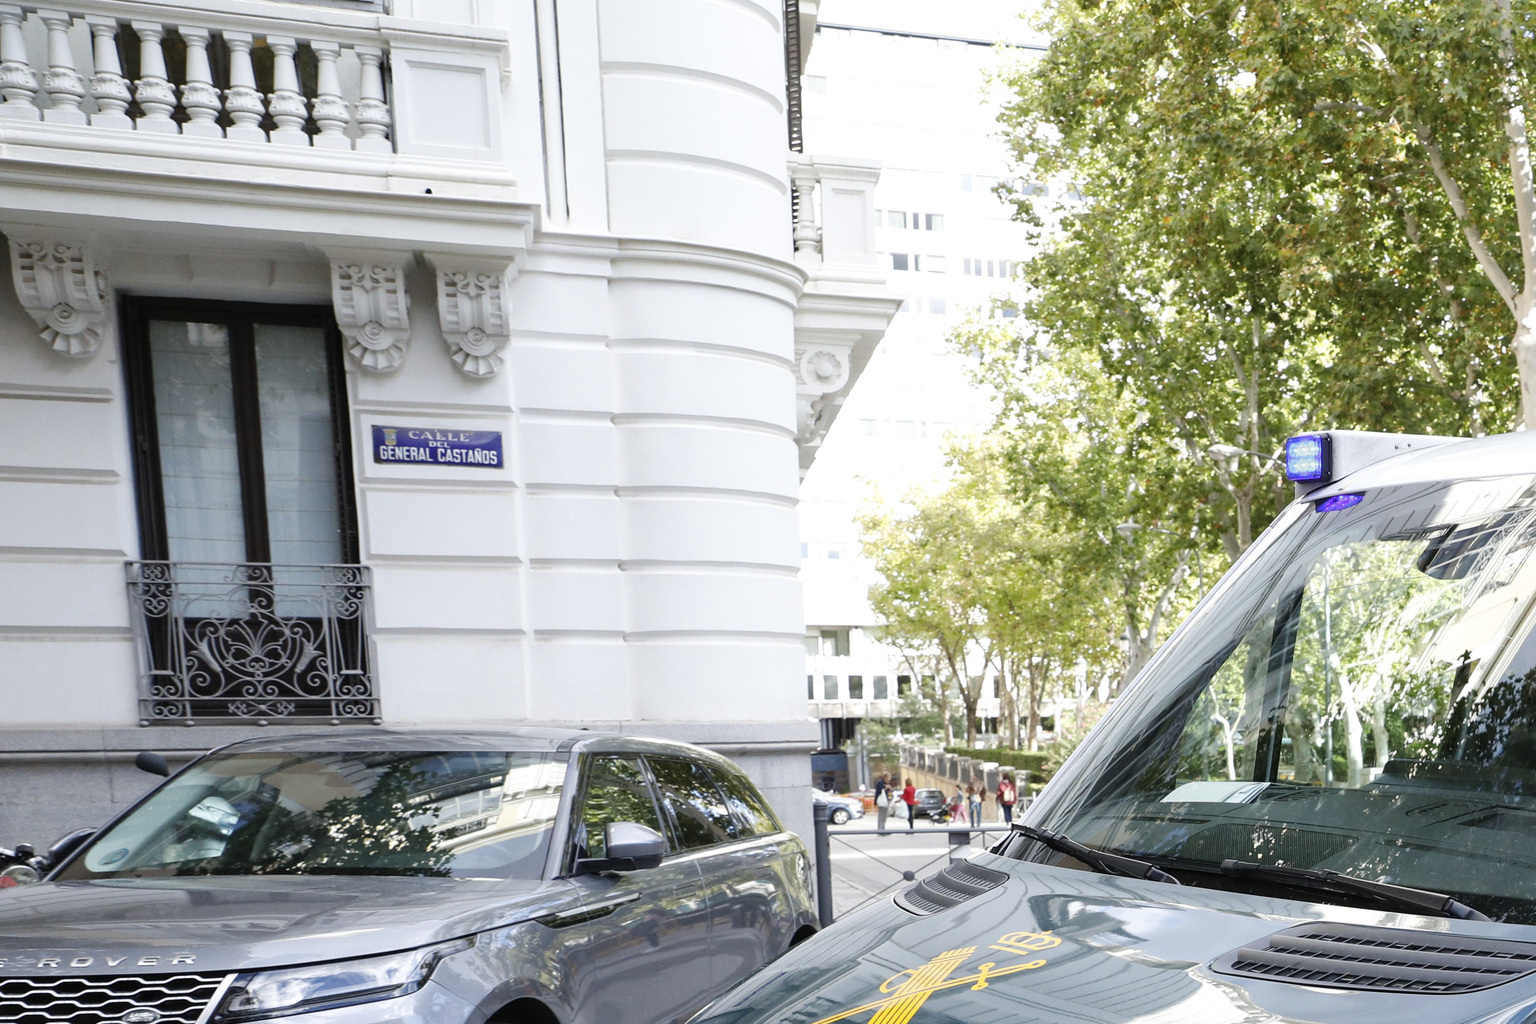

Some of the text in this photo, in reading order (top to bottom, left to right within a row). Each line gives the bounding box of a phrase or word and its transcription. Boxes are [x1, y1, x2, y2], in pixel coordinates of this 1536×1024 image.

[408, 430, 471, 442] CALLE
[380, 445, 498, 465] GENERAL CASTAÑOS
[37, 954, 197, 968] ROVER
